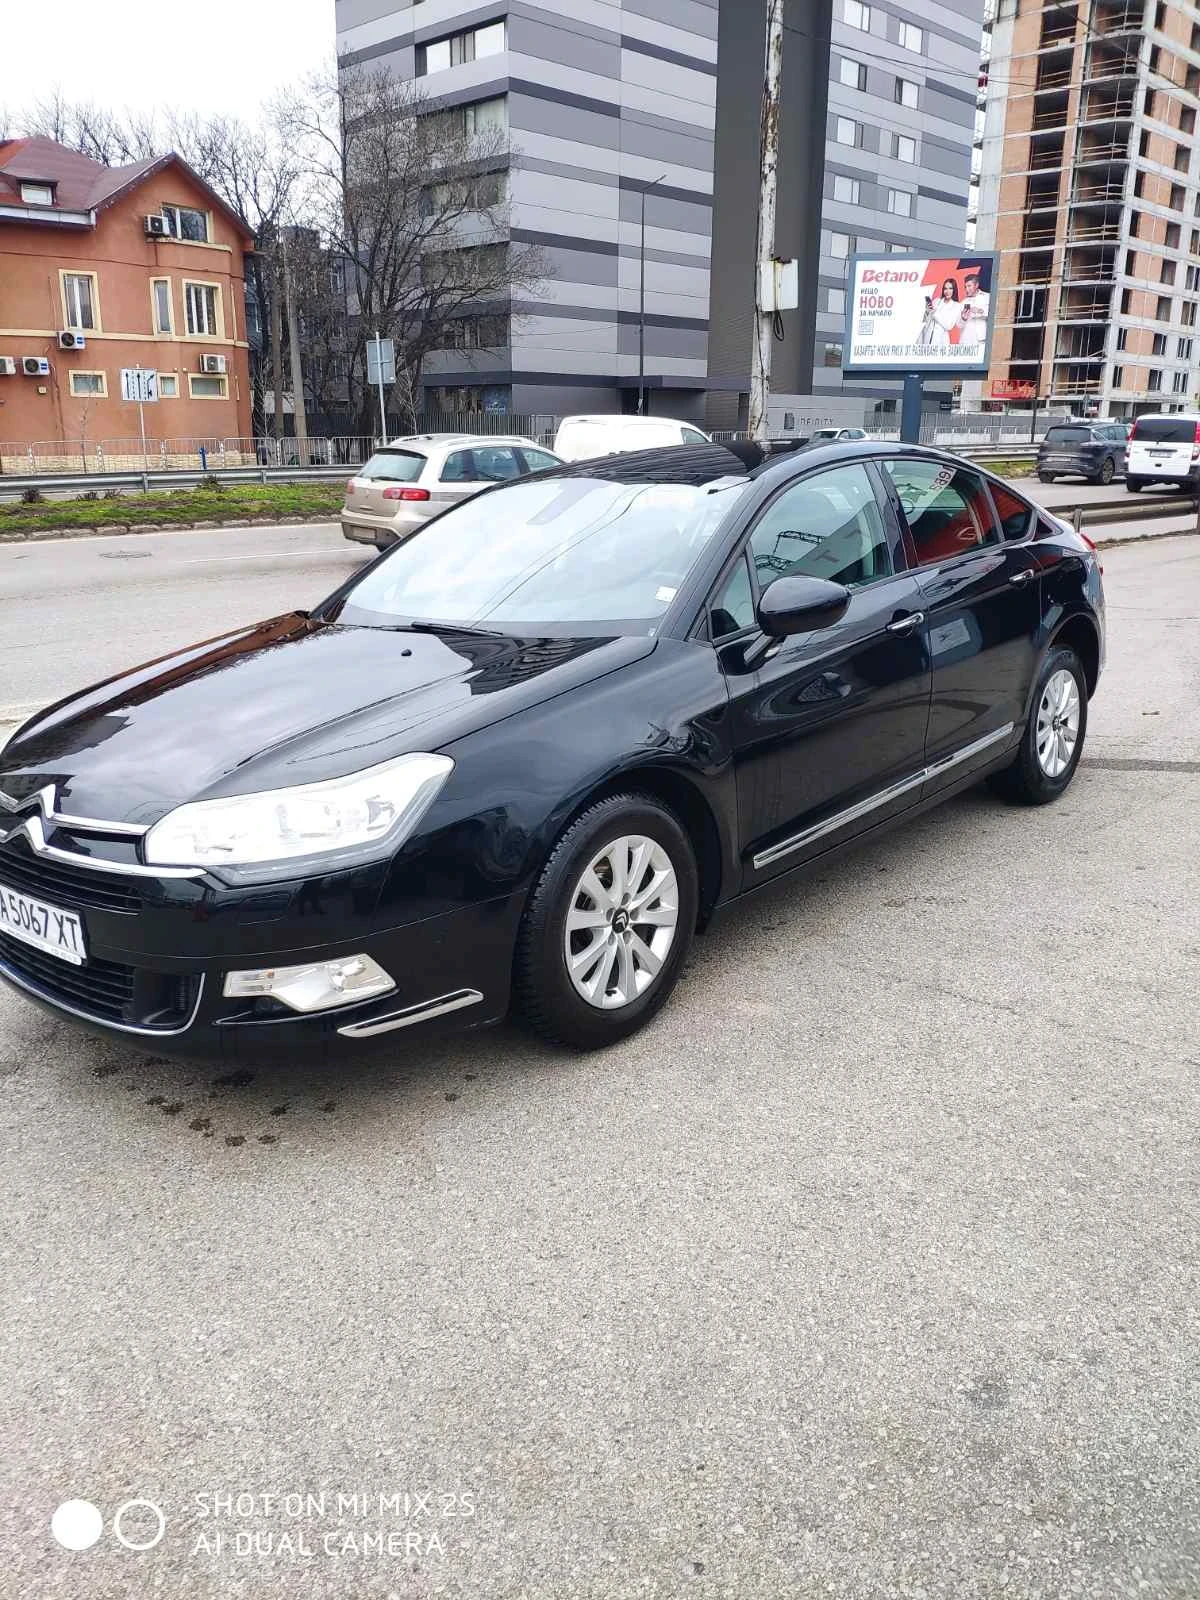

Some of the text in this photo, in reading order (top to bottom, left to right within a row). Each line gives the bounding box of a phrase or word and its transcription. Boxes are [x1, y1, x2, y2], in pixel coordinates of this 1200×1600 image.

[862, 269, 919, 283] Betano
[860, 287, 879, 295] НЕЩО
[859, 296, 894, 309] НОВО
